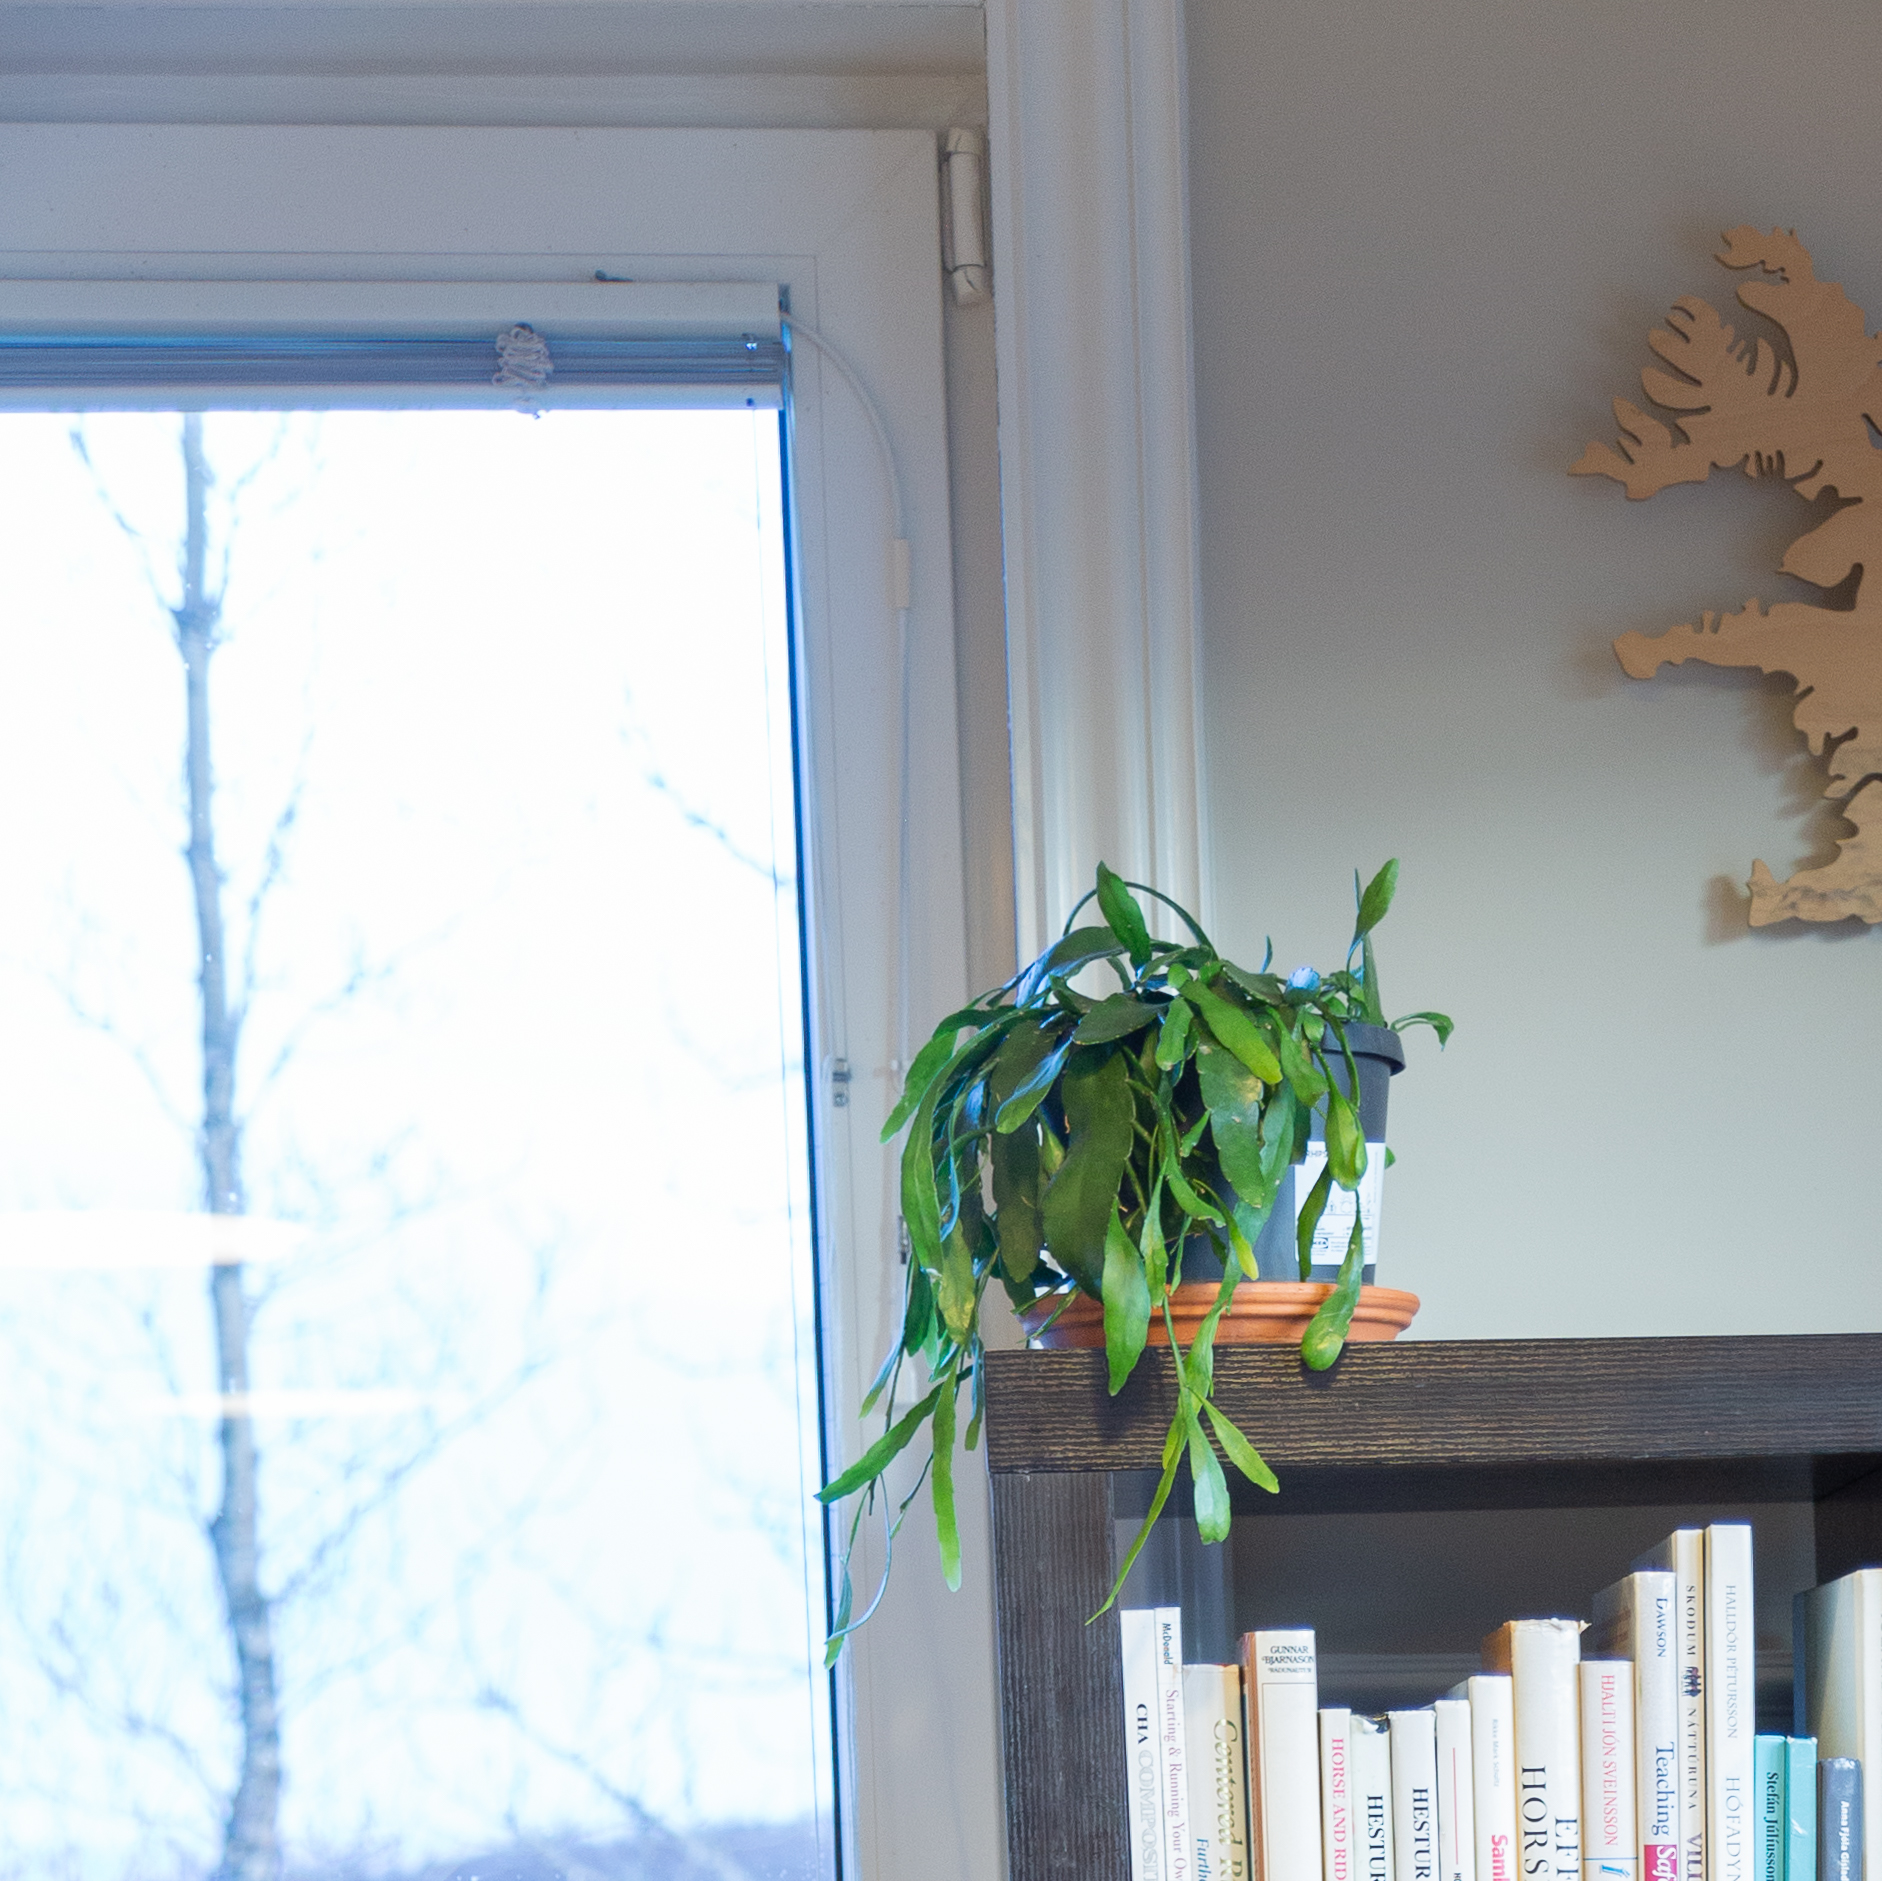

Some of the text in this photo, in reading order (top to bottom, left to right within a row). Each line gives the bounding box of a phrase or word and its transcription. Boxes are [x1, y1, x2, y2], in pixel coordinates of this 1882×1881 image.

[1270, 1646, 1308, 1654] GUNNAR
[1137, 1704, 1148, 1744] CHA
[1164, 1689, 1180, 1742] Starting
[1168, 1747, 1181, 1757] &
[1331, 1738, 1346, 1799] HORSE
[1601, 1675, 1620, 1846] HJALTI JÓN SVEINSSON
[1167, 1763, 1184, 1818] Running
[1213, 1719, 1243, 1845] Centered
[1652, 1742, 1675, 1836] Teaching
[1171, 1822, 1185, 1853] Your
[1333, 1804, 1347, 1842] AND
[1412, 1788, 1432, 1880] HESTUR
